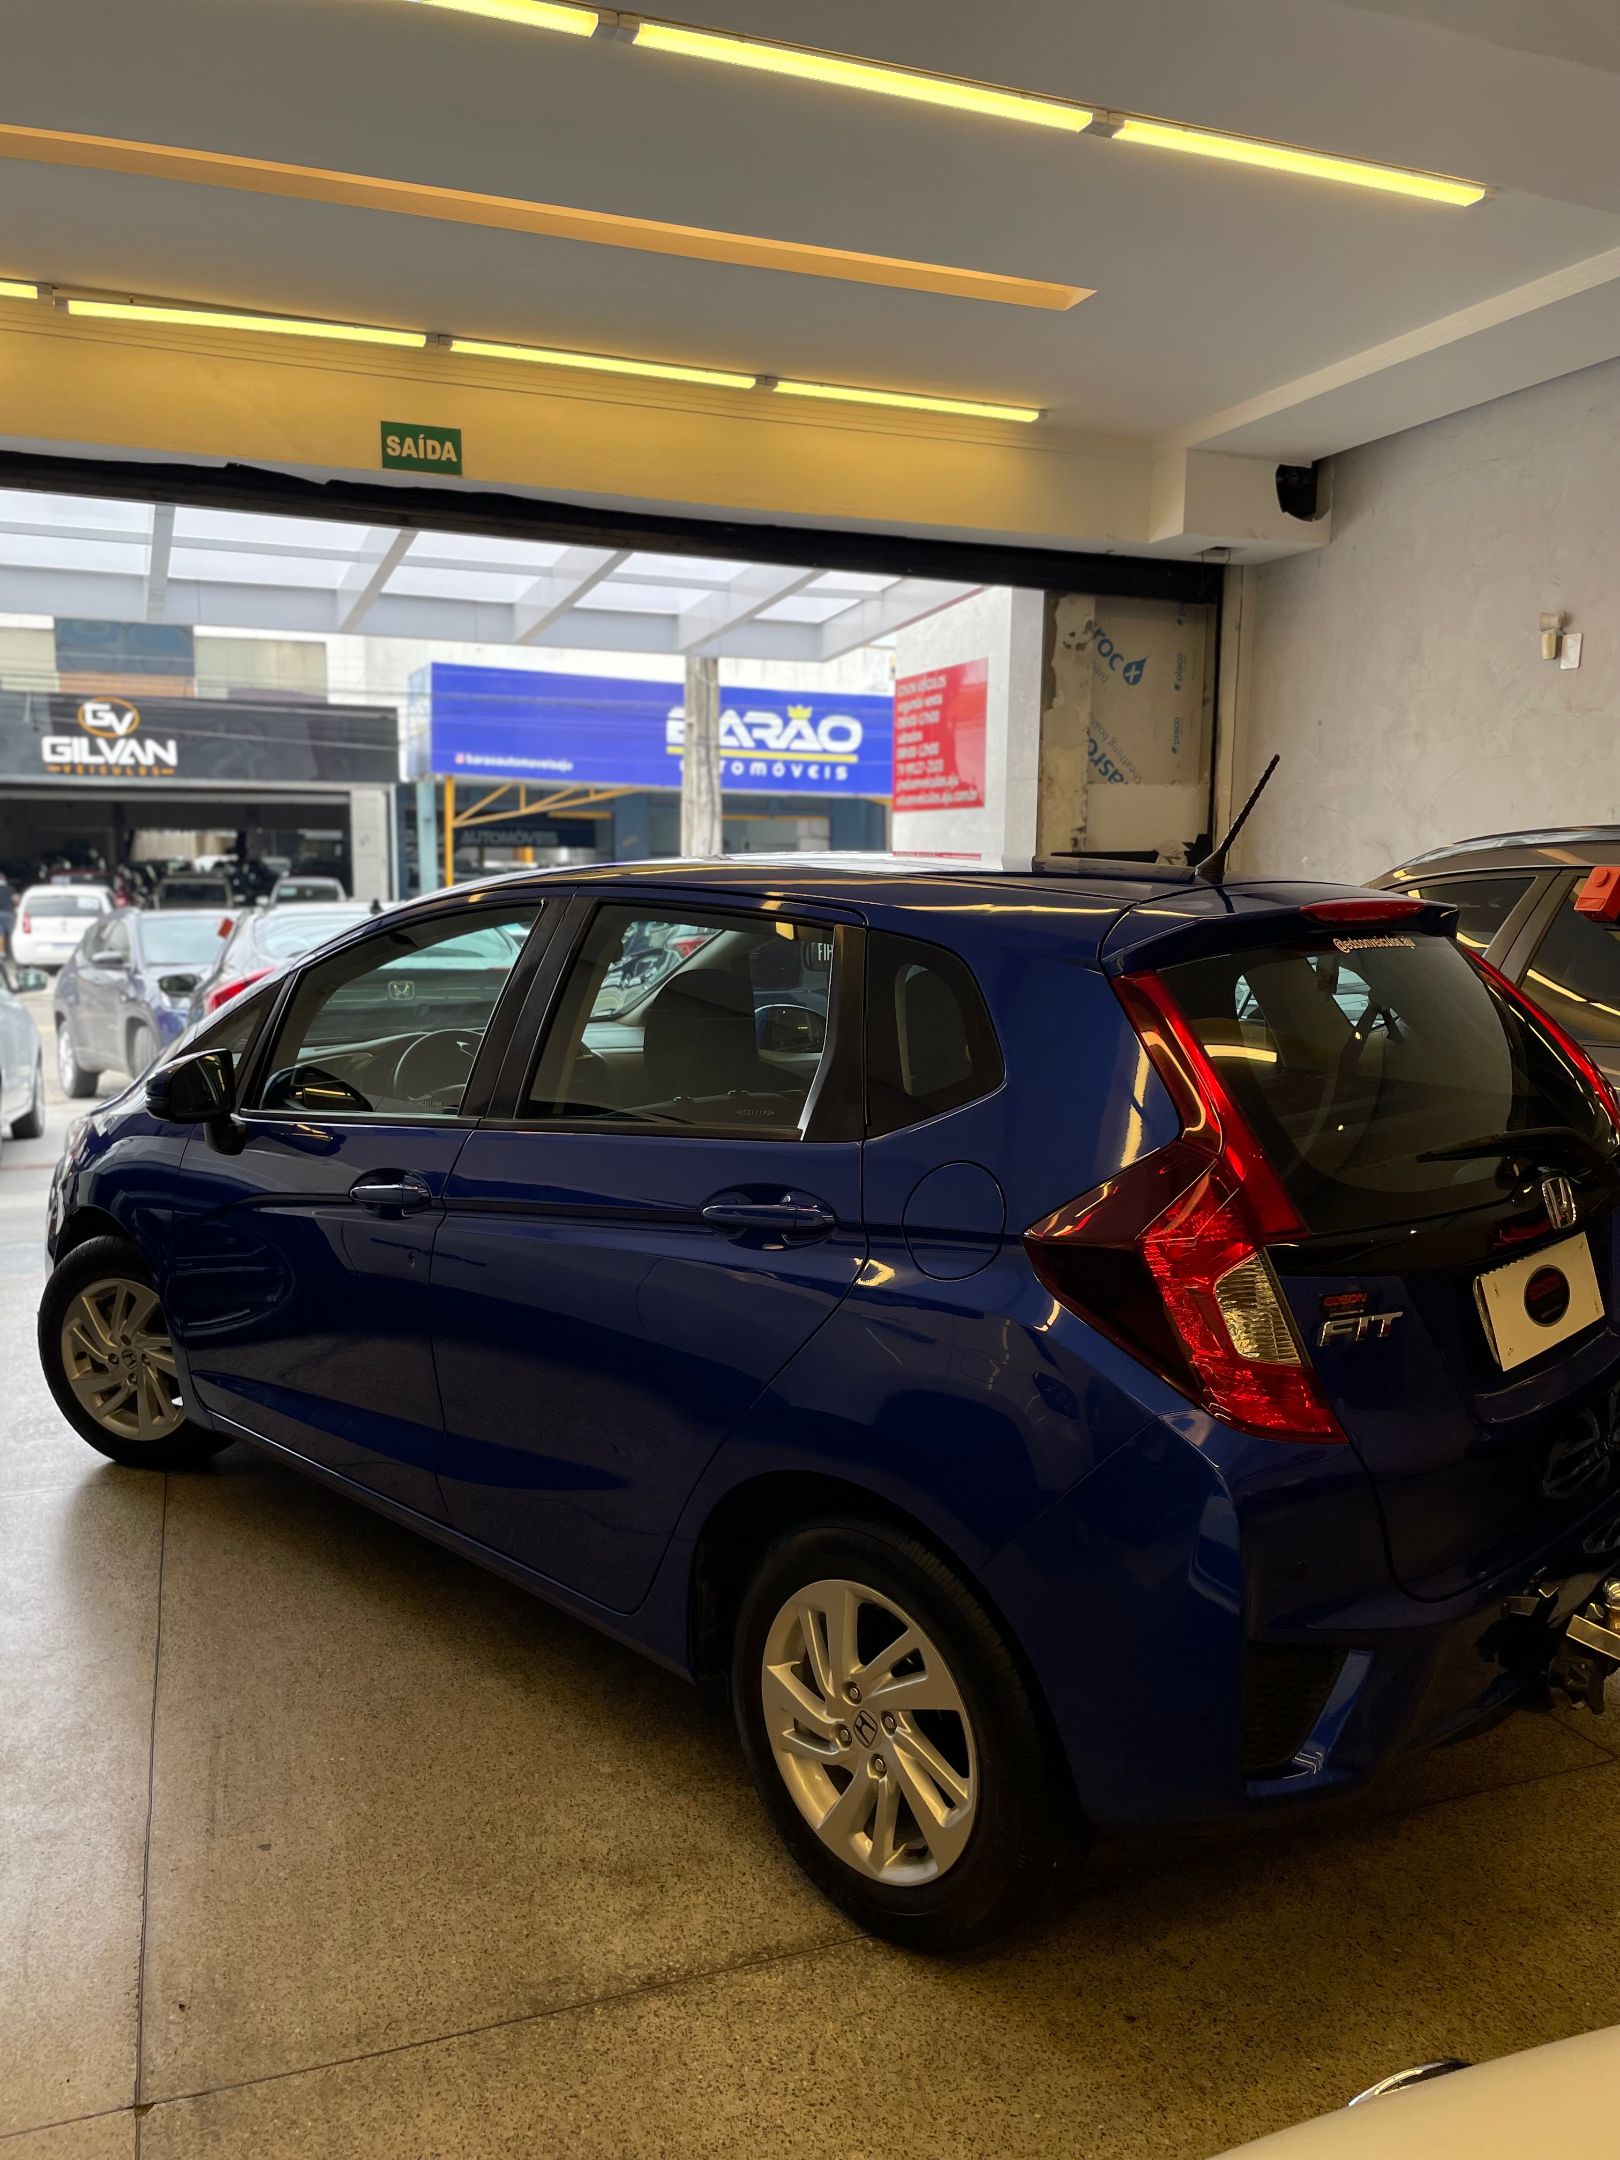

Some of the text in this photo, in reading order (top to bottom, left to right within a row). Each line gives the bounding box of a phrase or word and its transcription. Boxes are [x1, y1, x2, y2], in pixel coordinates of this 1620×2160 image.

[386, 433, 458, 462] SAÍDA
[84, 702, 134, 736] GV
[41, 736, 178, 766] GILVAN
[1319, 1311, 1403, 1347] FIT
